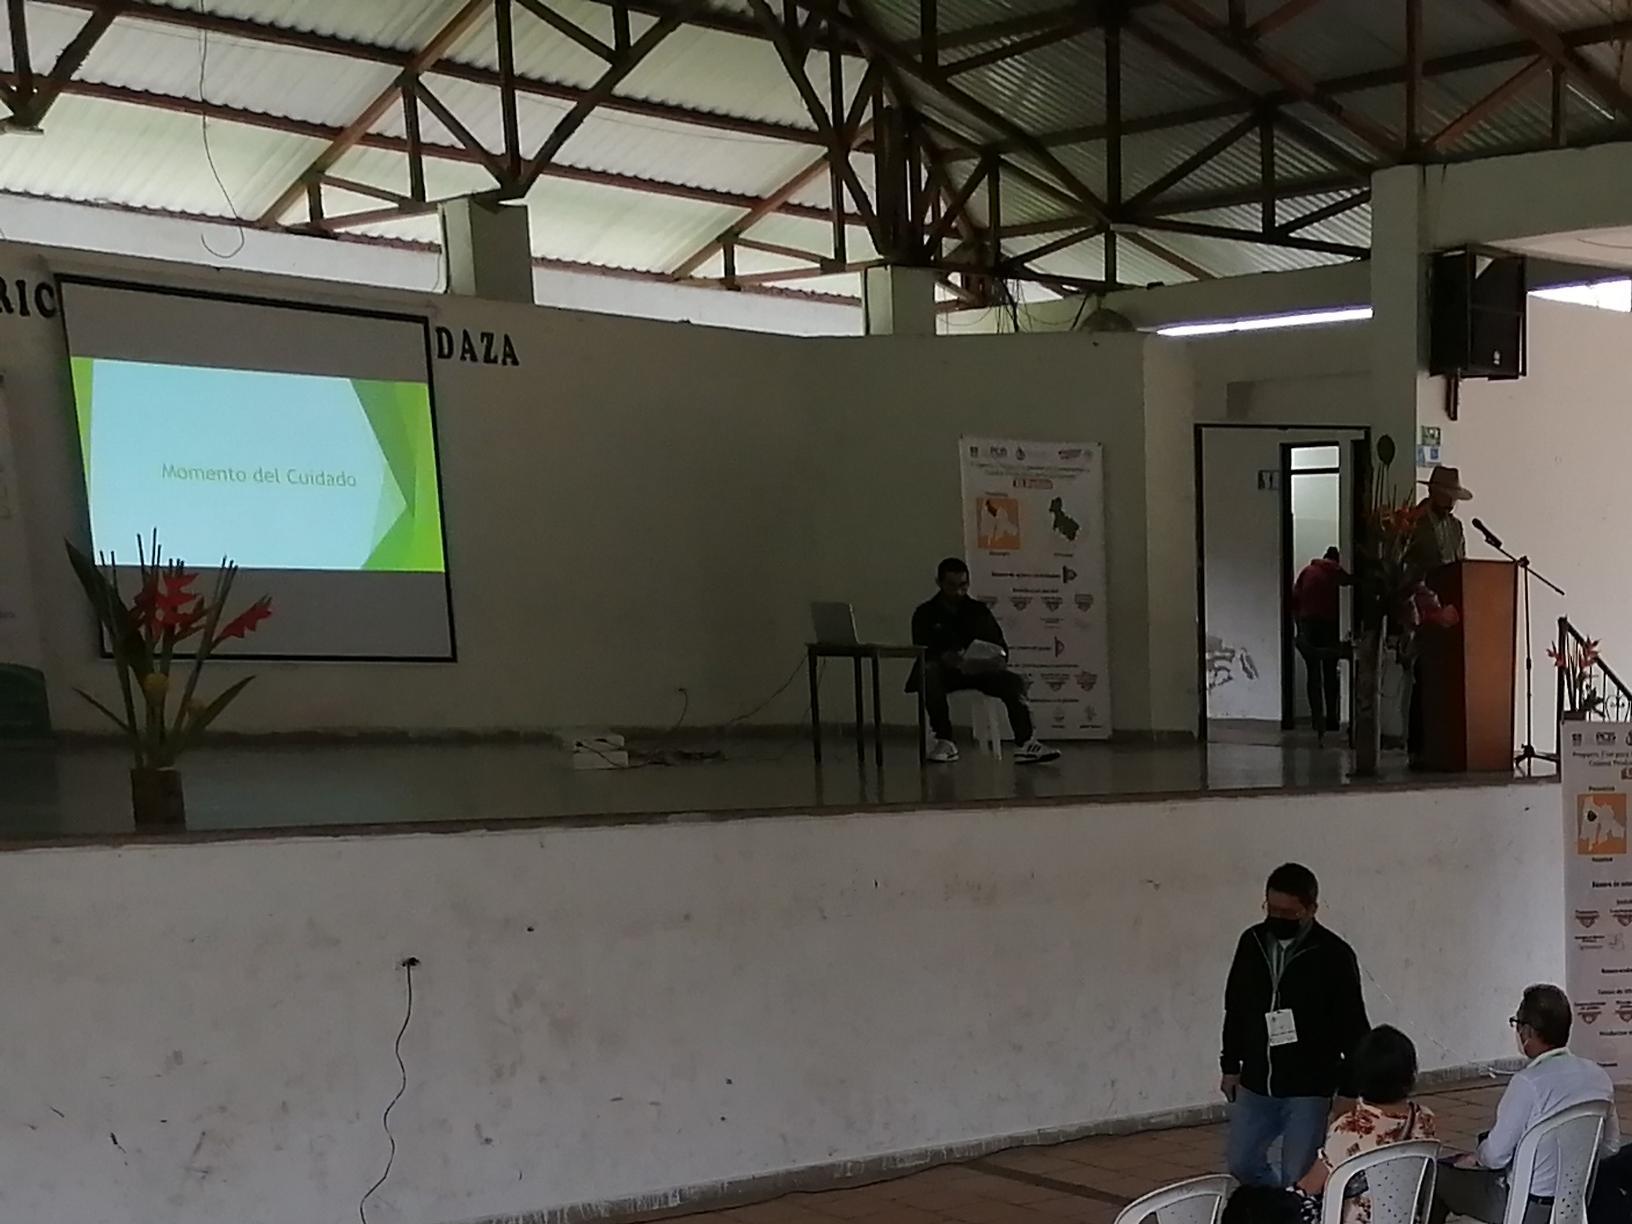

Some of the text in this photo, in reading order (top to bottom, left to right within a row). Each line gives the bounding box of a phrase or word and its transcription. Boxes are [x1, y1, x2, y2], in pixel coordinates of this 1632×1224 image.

[435, 326, 519, 366] DAZA
[161, 463, 357, 487] Momento del Cuidado
